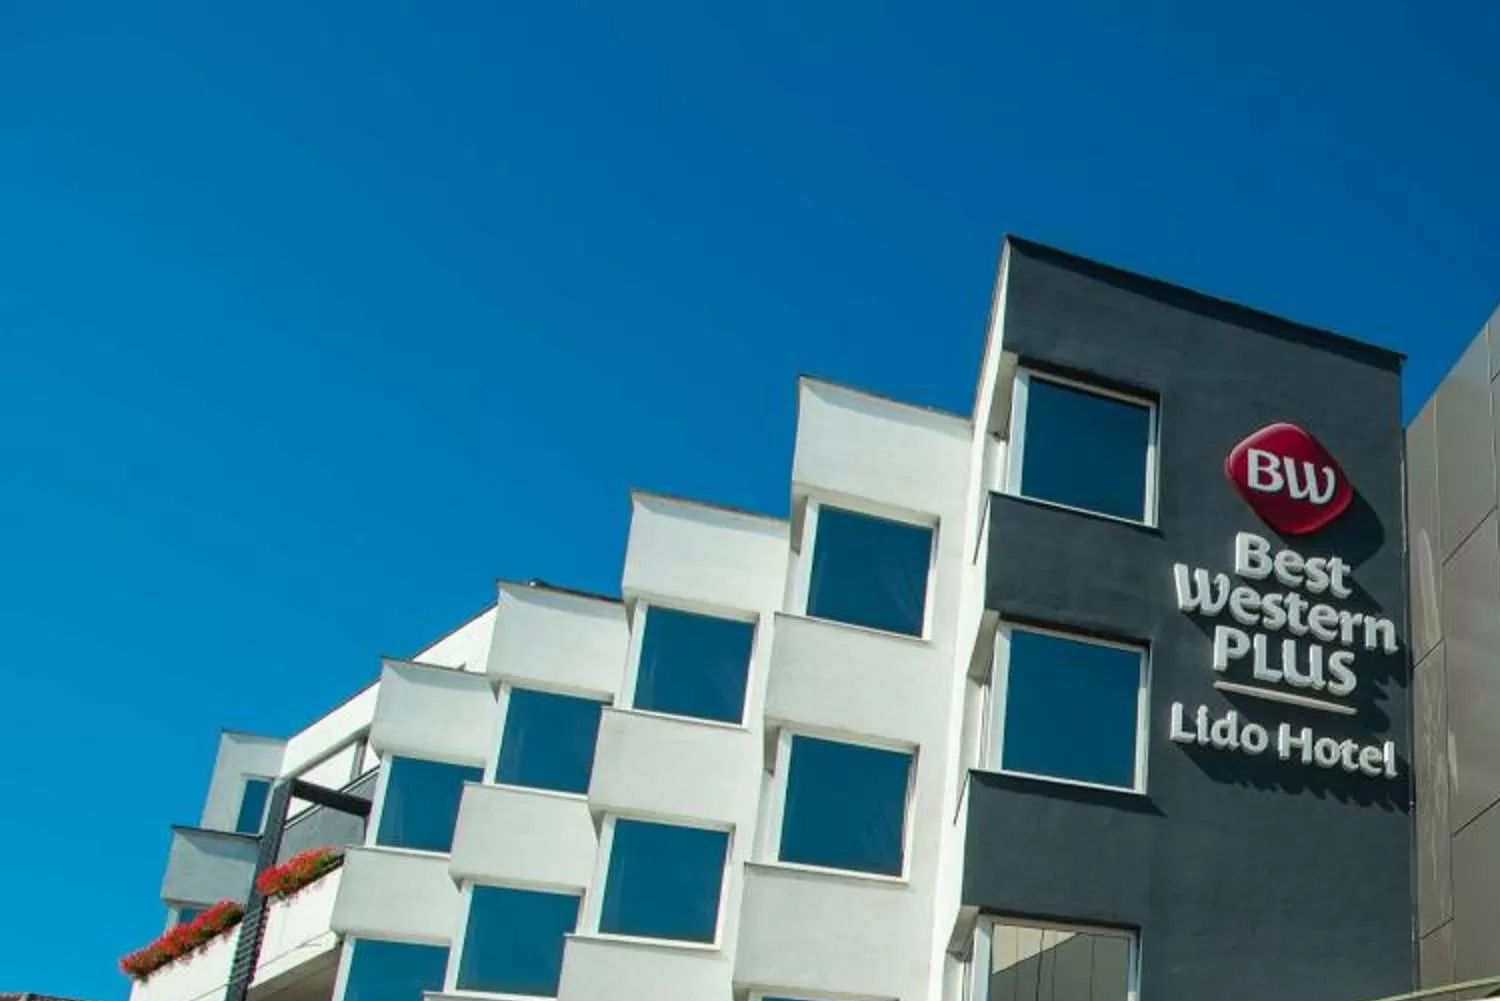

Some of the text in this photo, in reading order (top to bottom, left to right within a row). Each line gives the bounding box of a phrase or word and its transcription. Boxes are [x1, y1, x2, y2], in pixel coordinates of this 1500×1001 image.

[1247, 448, 1336, 505] BW
[1235, 531, 1352, 599] Best
[1173, 562, 1399, 654] Western
[1212, 625, 1357, 696] PLUS
[1169, 702, 1399, 779] Lido Hotel
